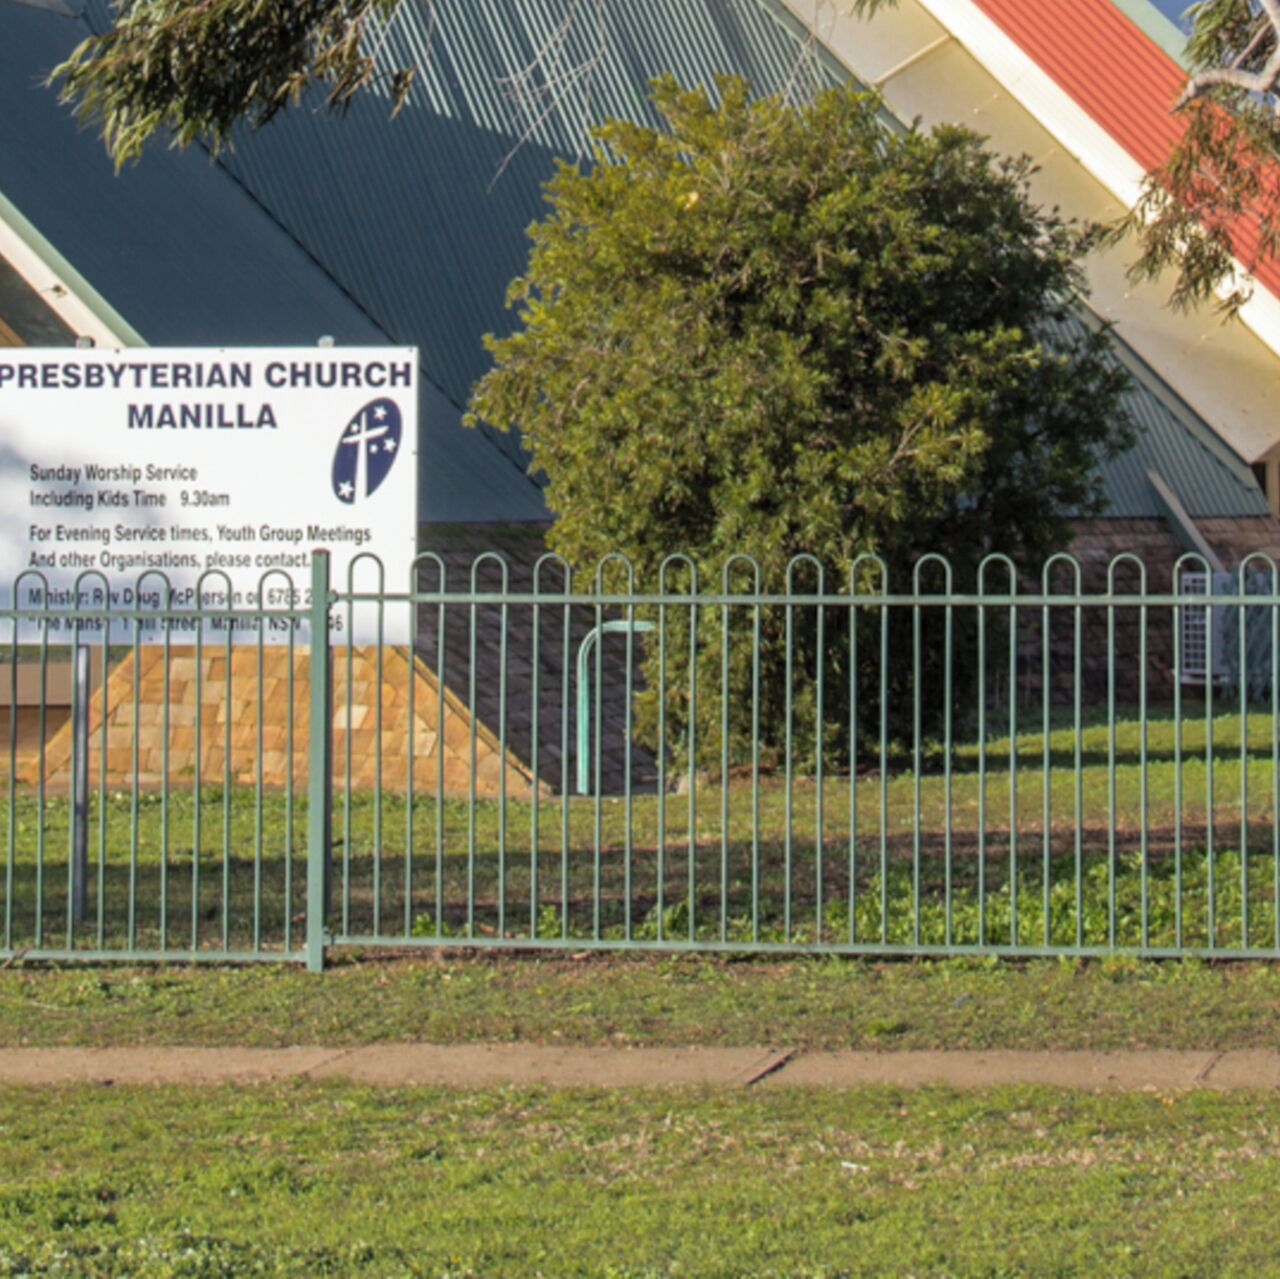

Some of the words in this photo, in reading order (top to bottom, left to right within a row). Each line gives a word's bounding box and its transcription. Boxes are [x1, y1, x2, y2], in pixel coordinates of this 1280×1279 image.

[264, 362, 412, 387] CHURCH
[127, 404, 278, 429] MANILLA
[30, 464, 81, 486] Sunday
[84, 464, 142, 484] Worship
[145, 464, 198, 482] Service
[30, 490, 94, 512] Including
[97, 490, 129, 507] Kids
[133, 490, 167, 507] Time
[180, 490, 230, 507] 9.30am
[29, 525, 51, 542] For
[56, 524, 111, 546] Evening
[114, 524, 167, 542] Service
[170, 524, 213, 543] times,
[217, 524, 256, 542] Youth
[259, 524, 304, 546] Group
[307, 524, 372, 546] Meetings
[28, 551, 56, 569] And
[59, 551, 96, 568] other
[100, 550, 201, 572] Organisations,
[205, 551, 252, 572] please
[93, 588, 120, 605] Rv
